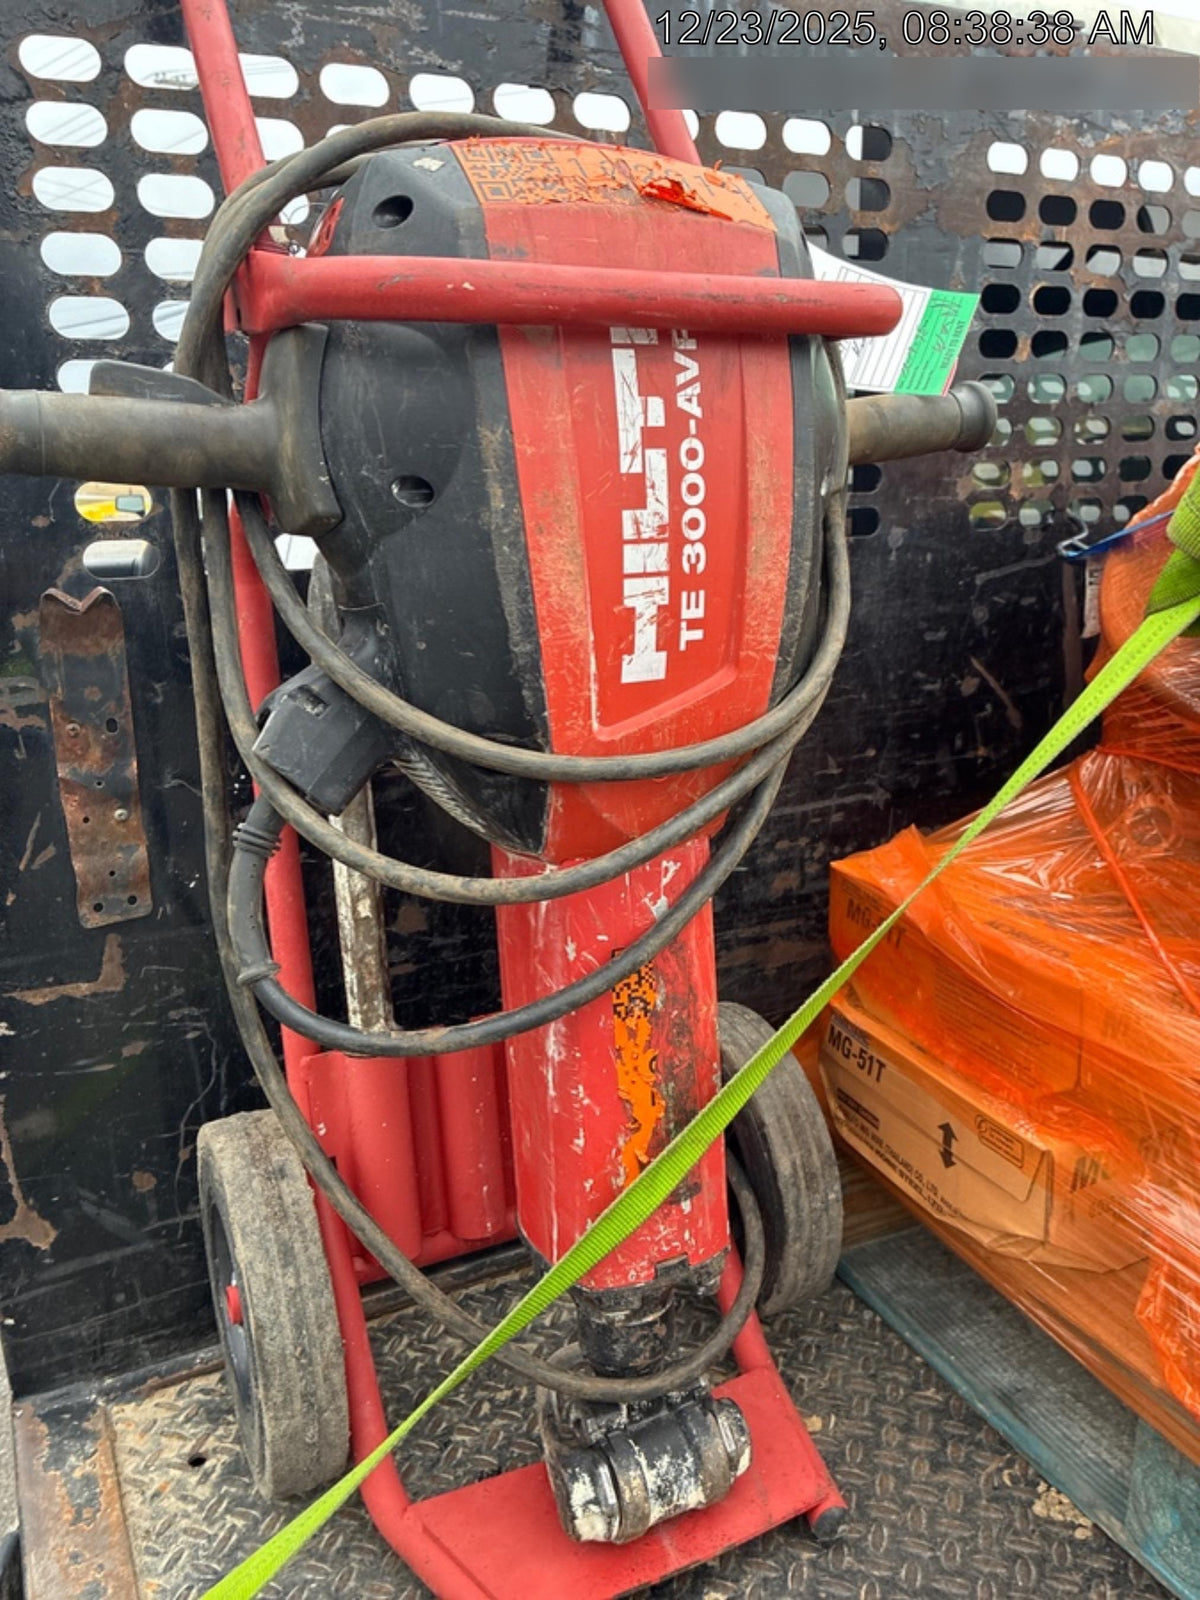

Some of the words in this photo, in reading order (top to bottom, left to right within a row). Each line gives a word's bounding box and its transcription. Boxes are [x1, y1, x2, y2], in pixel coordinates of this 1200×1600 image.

[609, 327, 670, 684] HILTI
[679, 589, 705, 651] TE
[846, 899, 907, 949] MG-1T
[828, 1023, 886, 1083] MG-51T
